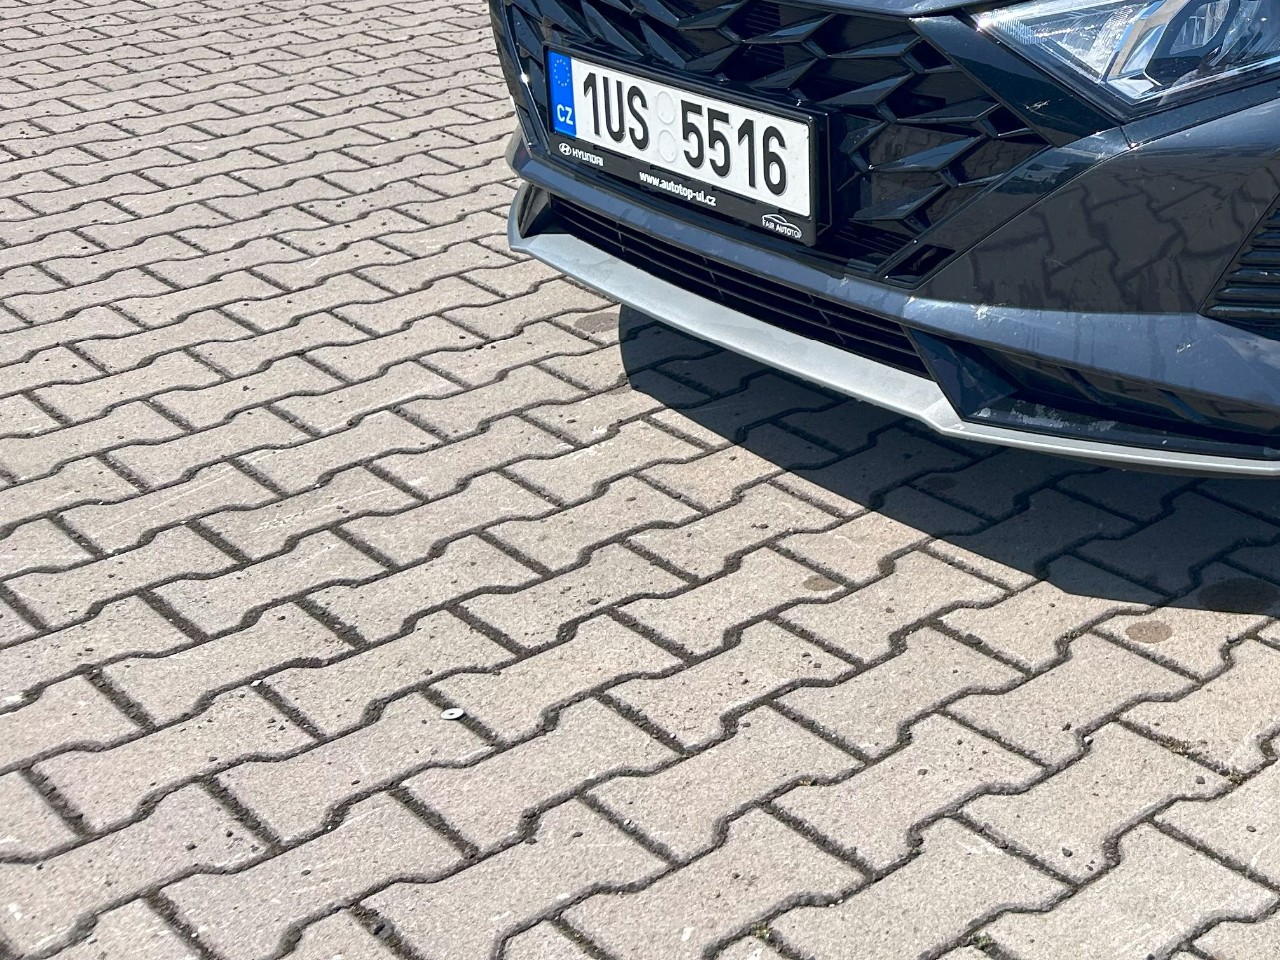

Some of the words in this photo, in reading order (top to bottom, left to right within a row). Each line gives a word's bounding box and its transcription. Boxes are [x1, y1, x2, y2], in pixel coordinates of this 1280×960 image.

[556, 103, 574, 126] CZ
[583, 72, 650, 151] 1US
[680, 99, 788, 197] 5516
[572, 148, 604, 167] HYUNDAI
[639, 171, 717, 207] www.autotop-ul.cz
